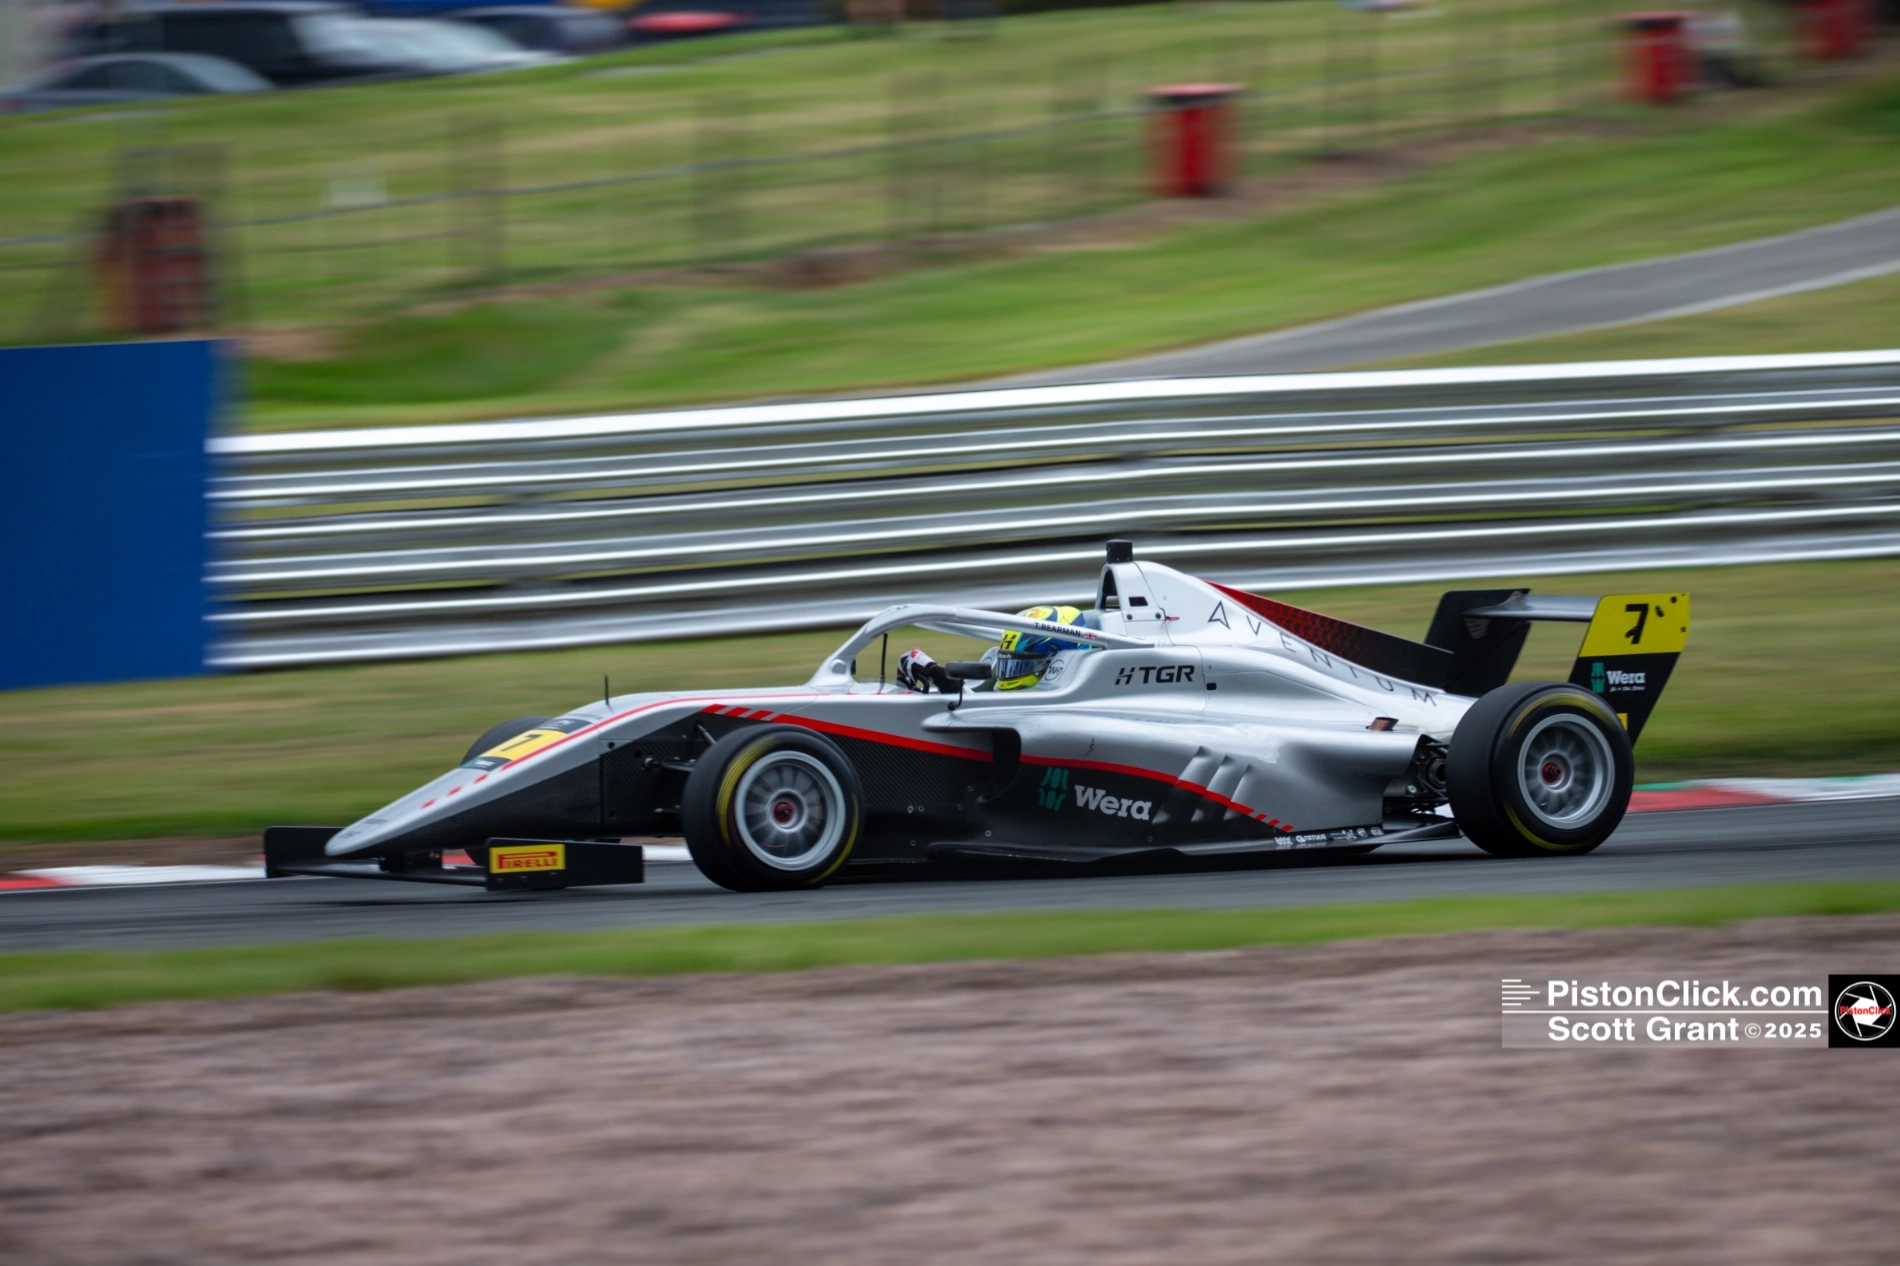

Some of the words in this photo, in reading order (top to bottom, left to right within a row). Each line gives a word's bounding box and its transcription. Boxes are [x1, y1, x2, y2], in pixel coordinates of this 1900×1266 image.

[1034, 622, 1081, 637] T.BEARMAN
[1625, 603, 1650, 645] 7
[1606, 670, 1646, 685] Wera
[500, 733, 543, 752] 7
[1074, 784, 1153, 821] Wera
[498, 851, 559, 869] PIRELLI
